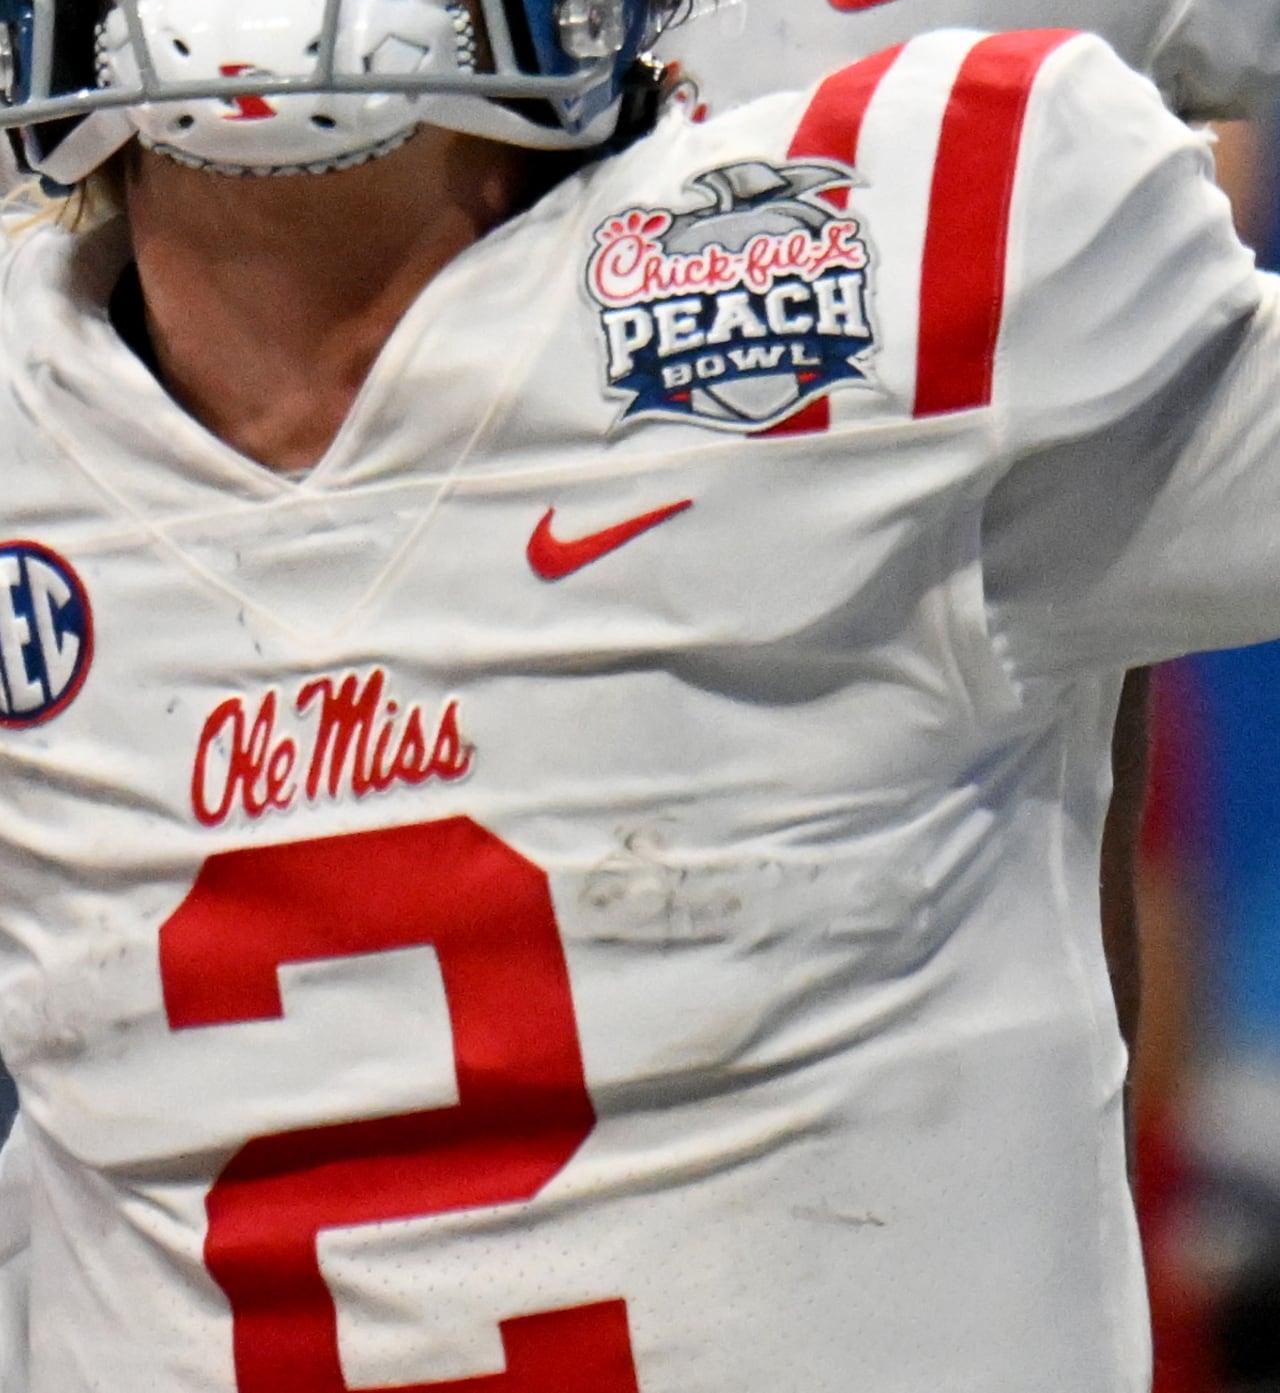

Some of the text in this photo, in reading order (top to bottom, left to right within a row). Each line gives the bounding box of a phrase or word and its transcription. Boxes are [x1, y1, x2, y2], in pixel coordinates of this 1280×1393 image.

[594, 211, 861, 301] Chick-fil-A
[603, 273, 869, 378] PEACH
[661, 342, 819, 389] BOWL
[191, 667, 473, 828] Ole Miss
[159, 814, 640, 1393] 2
